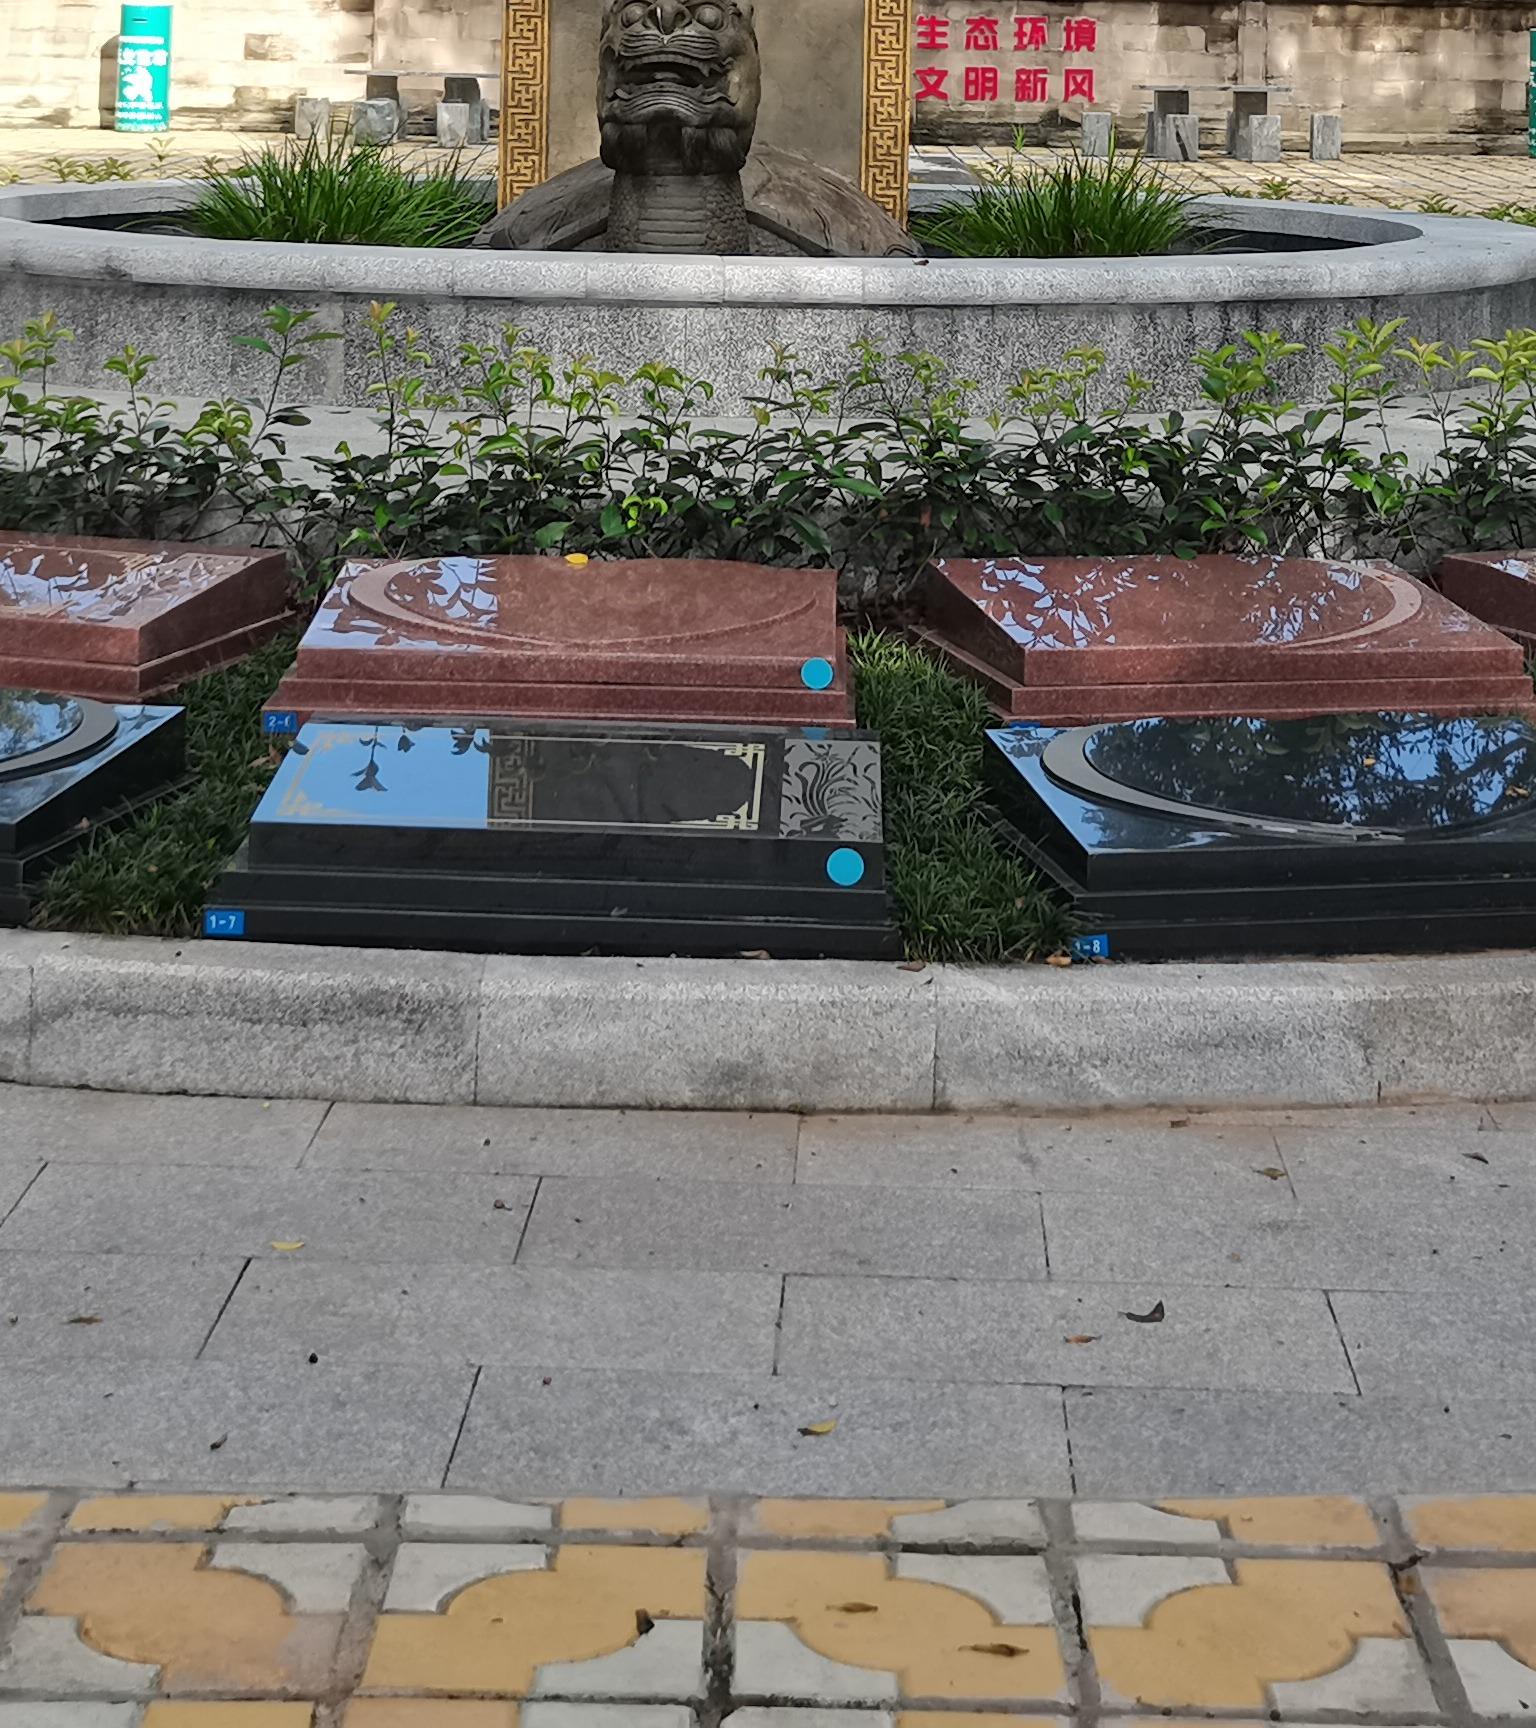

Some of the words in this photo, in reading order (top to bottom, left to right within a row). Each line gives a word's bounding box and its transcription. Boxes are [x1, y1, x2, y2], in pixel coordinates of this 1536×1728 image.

[915, 15, 1098, 53] 生态环境
[915, 66, 1097, 103] 文明新风
[209, 914, 236, 930] 1-7
[1074, 939, 1101, 954] 1-8
